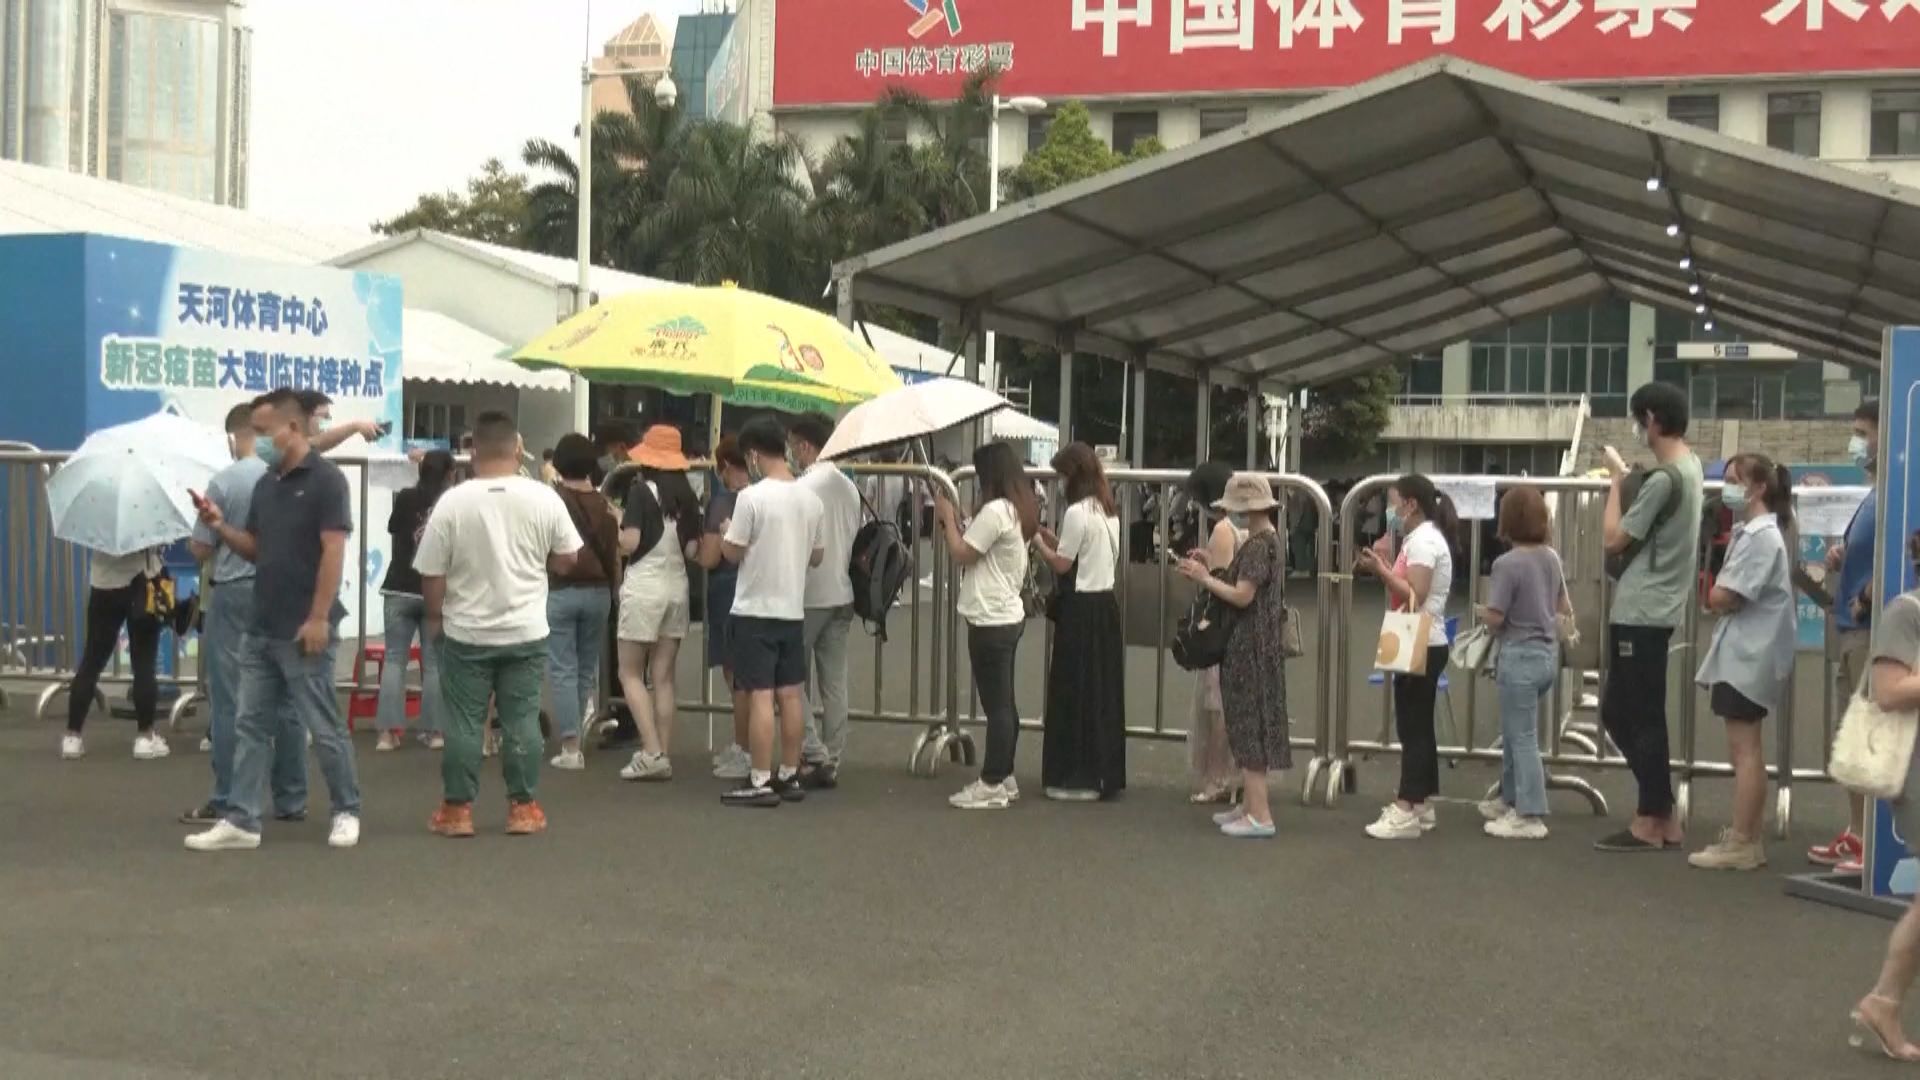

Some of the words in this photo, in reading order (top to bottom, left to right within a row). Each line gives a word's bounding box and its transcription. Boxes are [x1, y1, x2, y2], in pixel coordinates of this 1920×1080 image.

[855, 42, 1014, 78] 中国体育彩票
[178, 283, 329, 336] 天河体育中心
[103, 340, 384, 397] 新冠疫苗大型临时接种点
